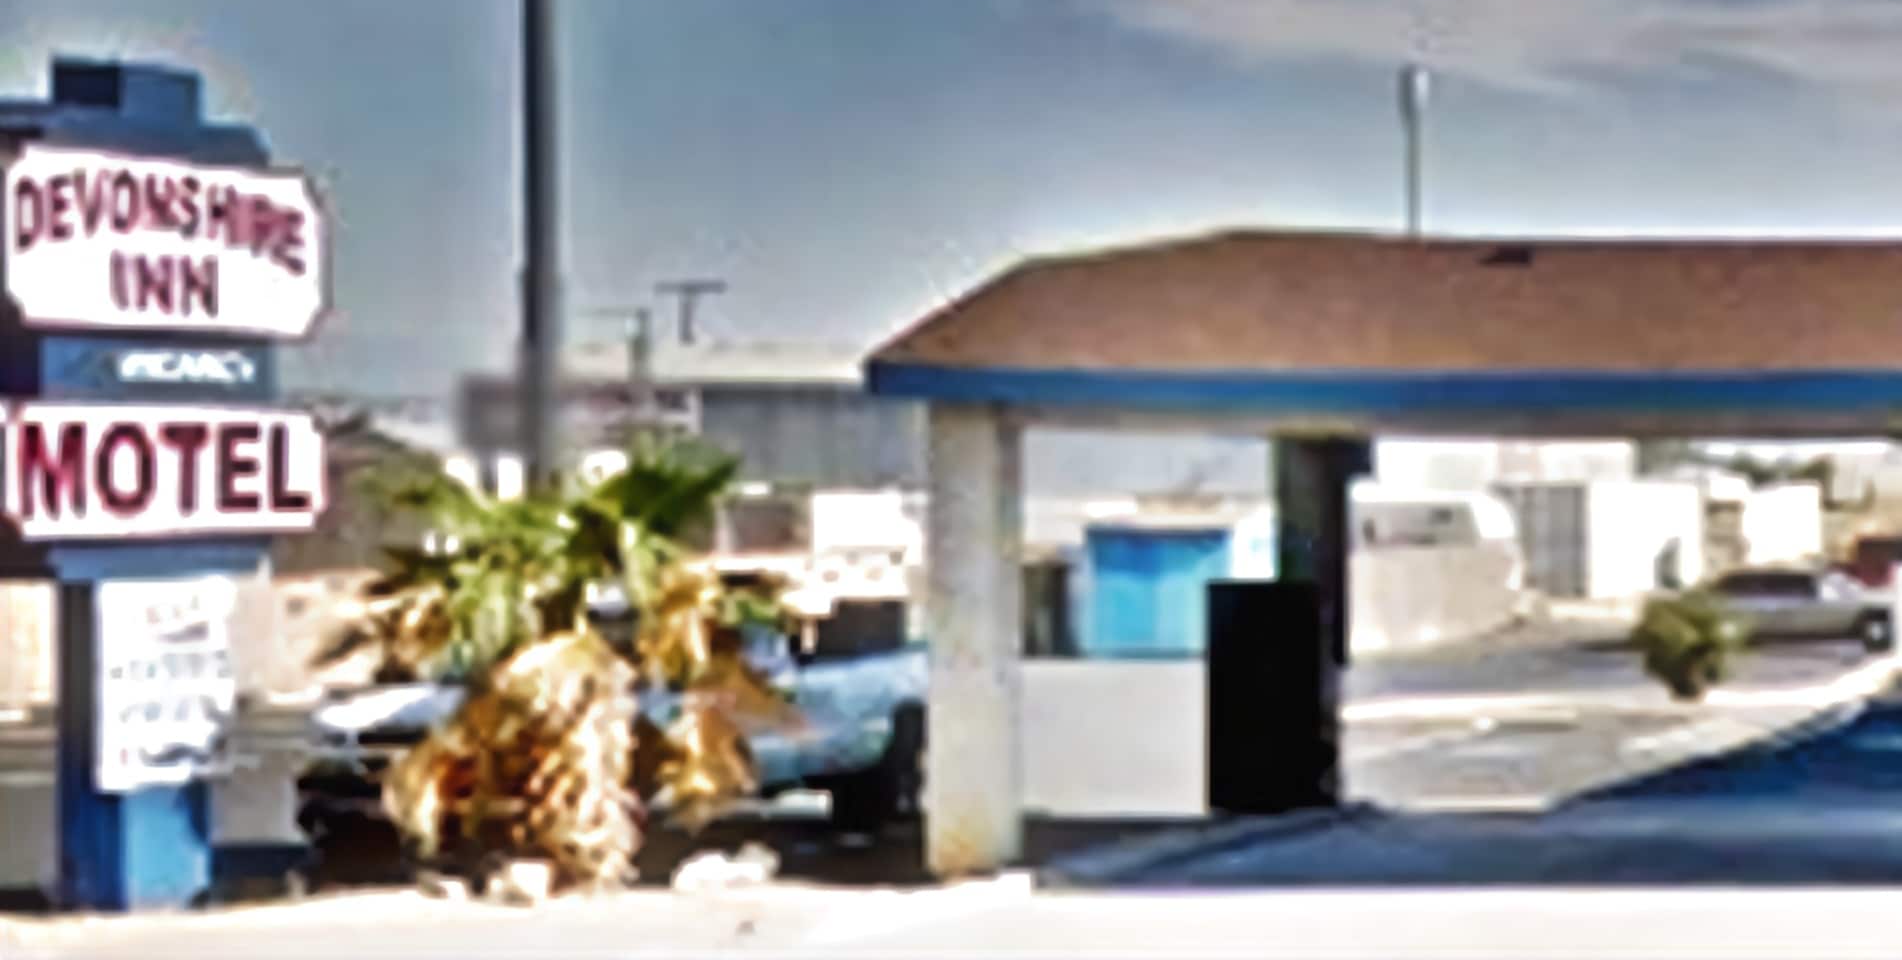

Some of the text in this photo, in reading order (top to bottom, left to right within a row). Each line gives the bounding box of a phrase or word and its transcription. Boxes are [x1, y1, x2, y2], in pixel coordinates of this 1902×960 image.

[14, 168, 306, 276] DEVONSHIRE
[110, 249, 219, 317] INN
[18, 421, 313, 521] MOTEL
